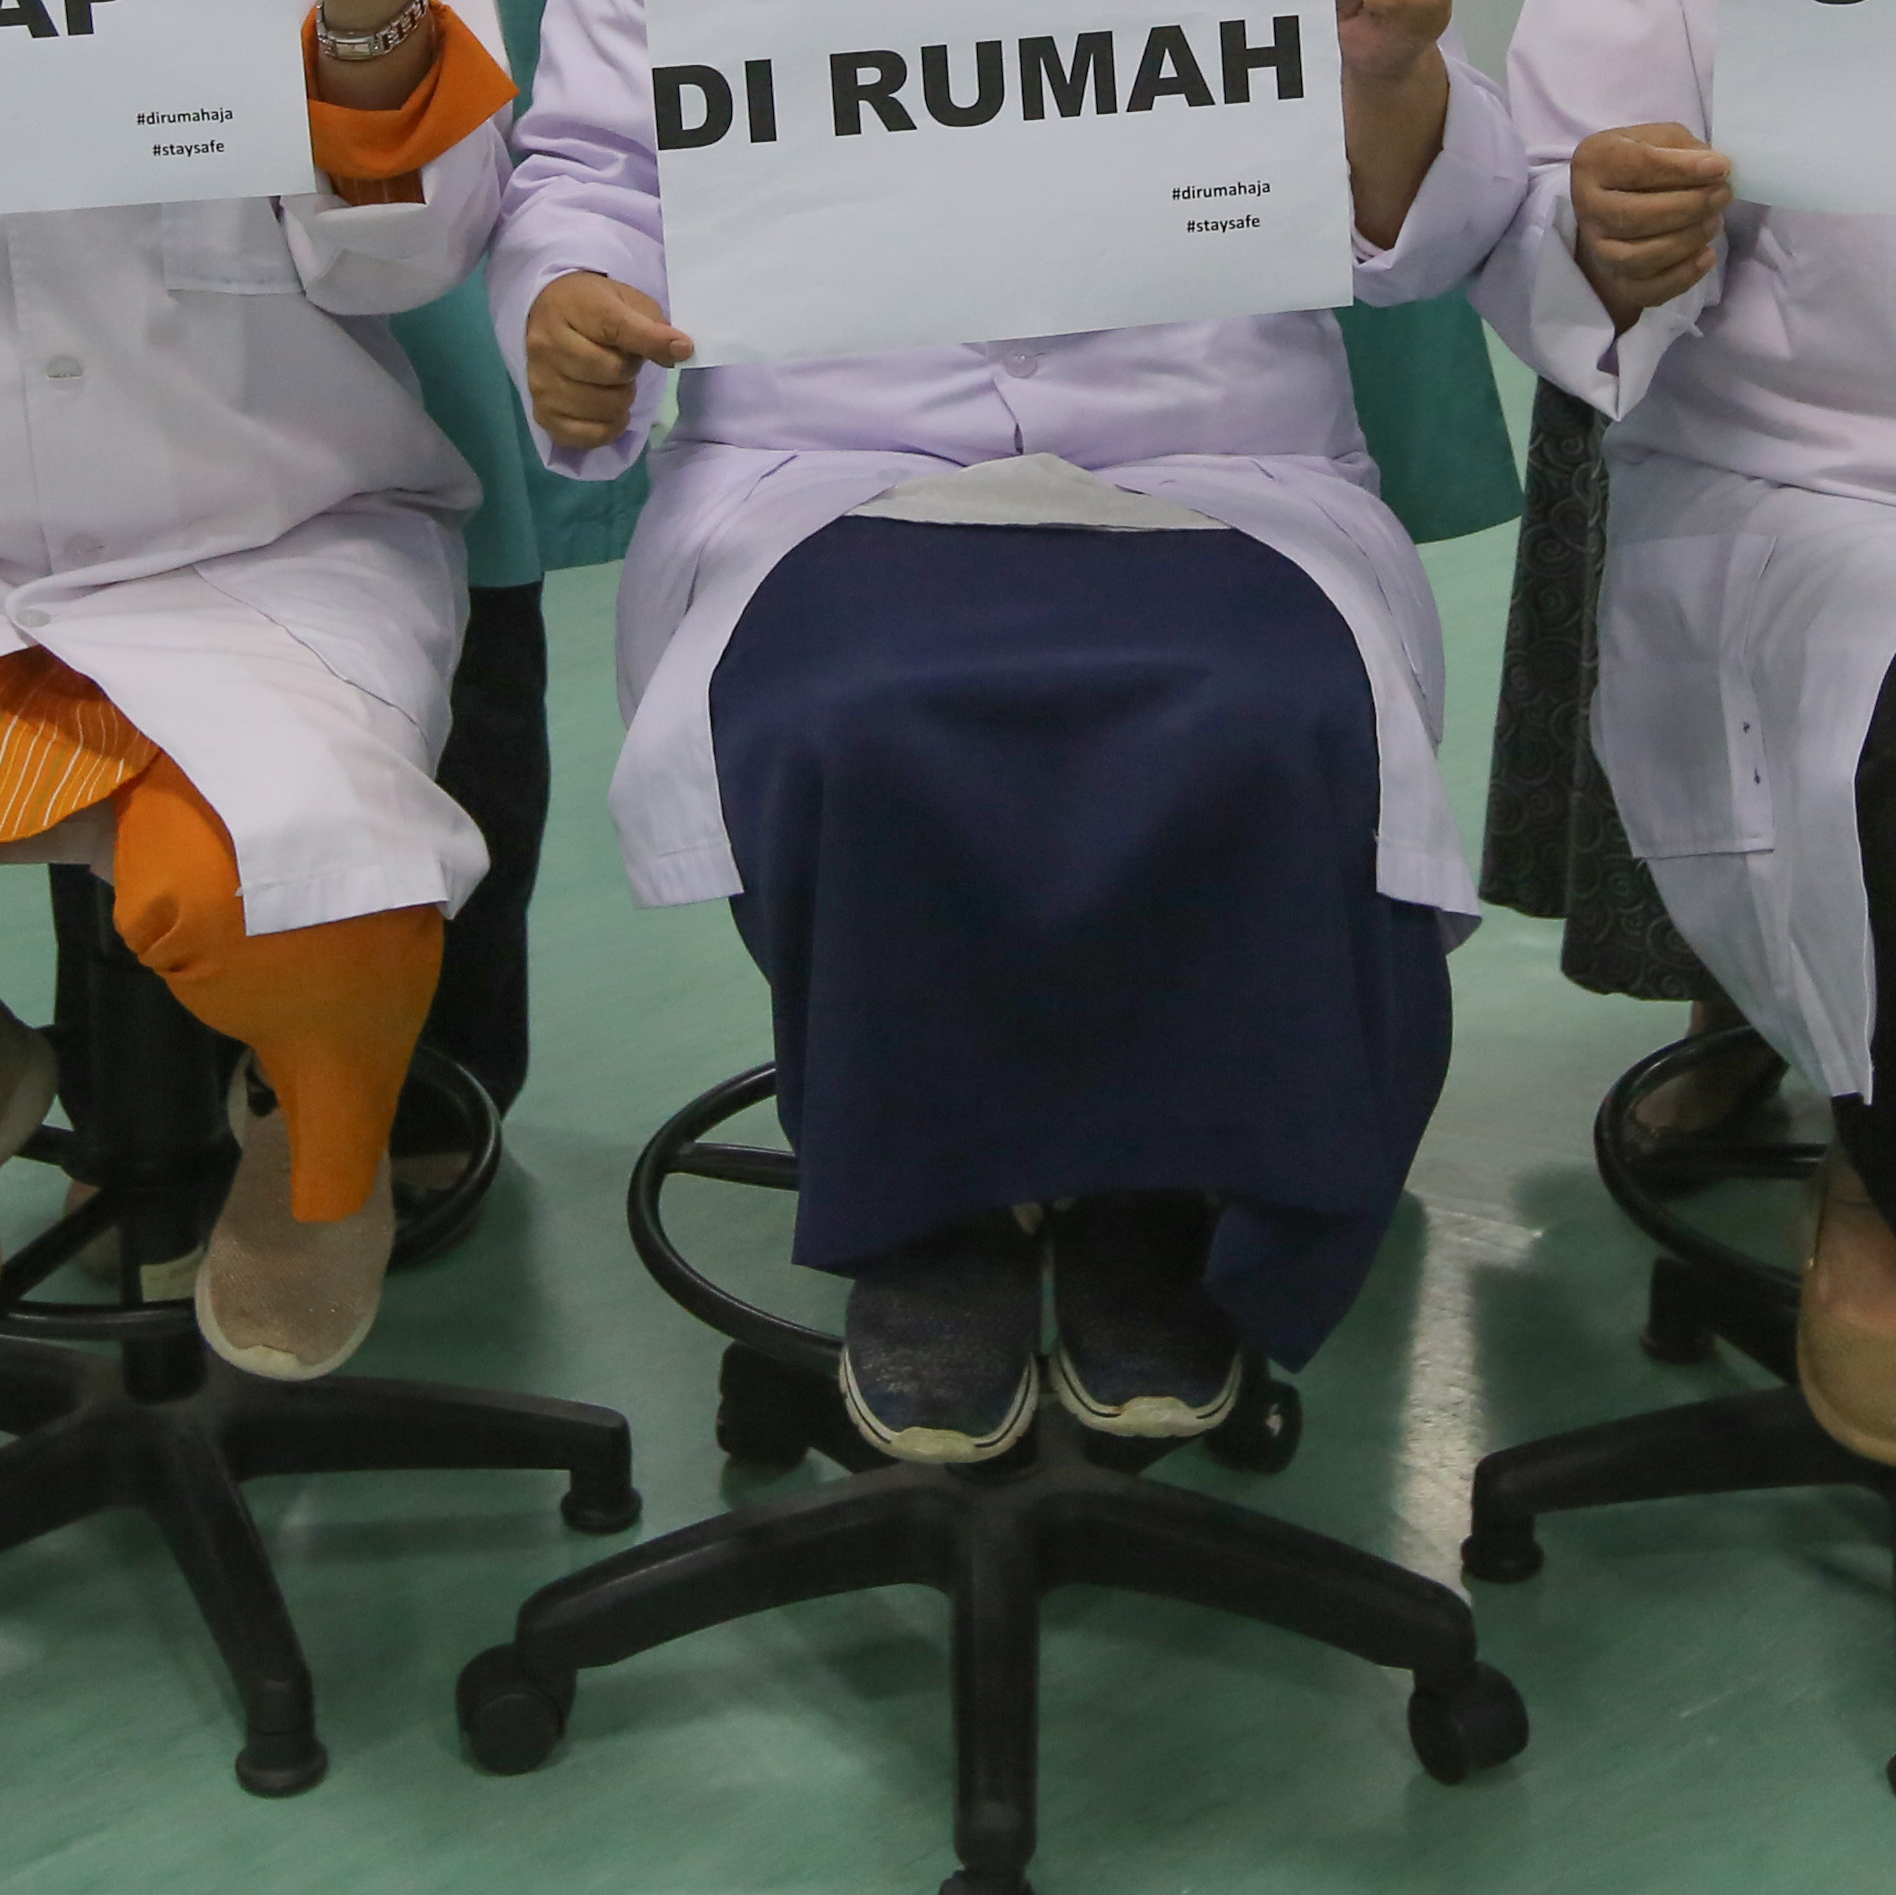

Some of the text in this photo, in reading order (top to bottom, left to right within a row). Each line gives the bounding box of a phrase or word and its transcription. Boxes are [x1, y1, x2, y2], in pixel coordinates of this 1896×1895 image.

[652, 15, 1304, 151] DI RUMAH
[136, 107, 233, 126] #dirumahaja
[152, 141, 225, 158] #staysafe
[1172, 180, 1270, 201] #dirumahaja
[1186, 215, 1260, 234] #staysafe
